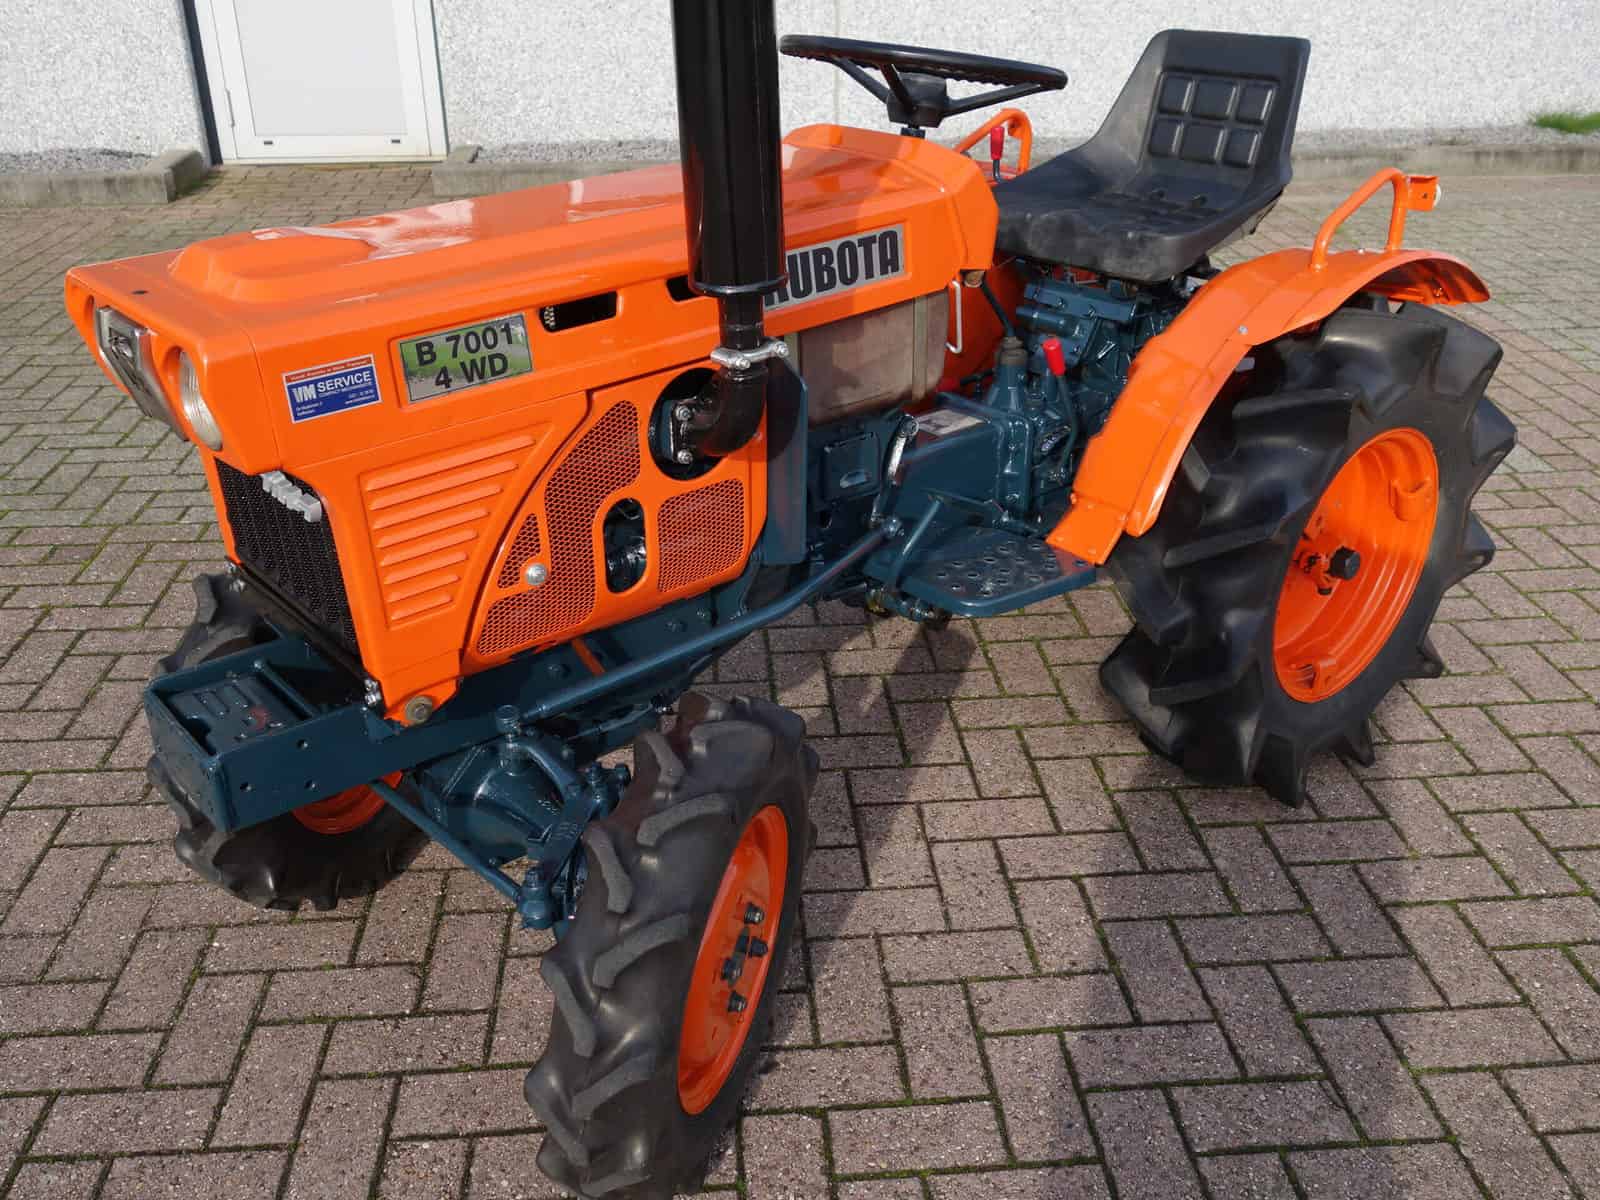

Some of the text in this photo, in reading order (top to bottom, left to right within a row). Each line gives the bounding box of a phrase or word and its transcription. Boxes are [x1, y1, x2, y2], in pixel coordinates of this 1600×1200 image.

[765, 230, 899, 307] UBOTA
[416, 322, 513, 366] B 7001
[317, 371, 371, 393] SERVICE
[435, 353, 508, 388] 4 WD
